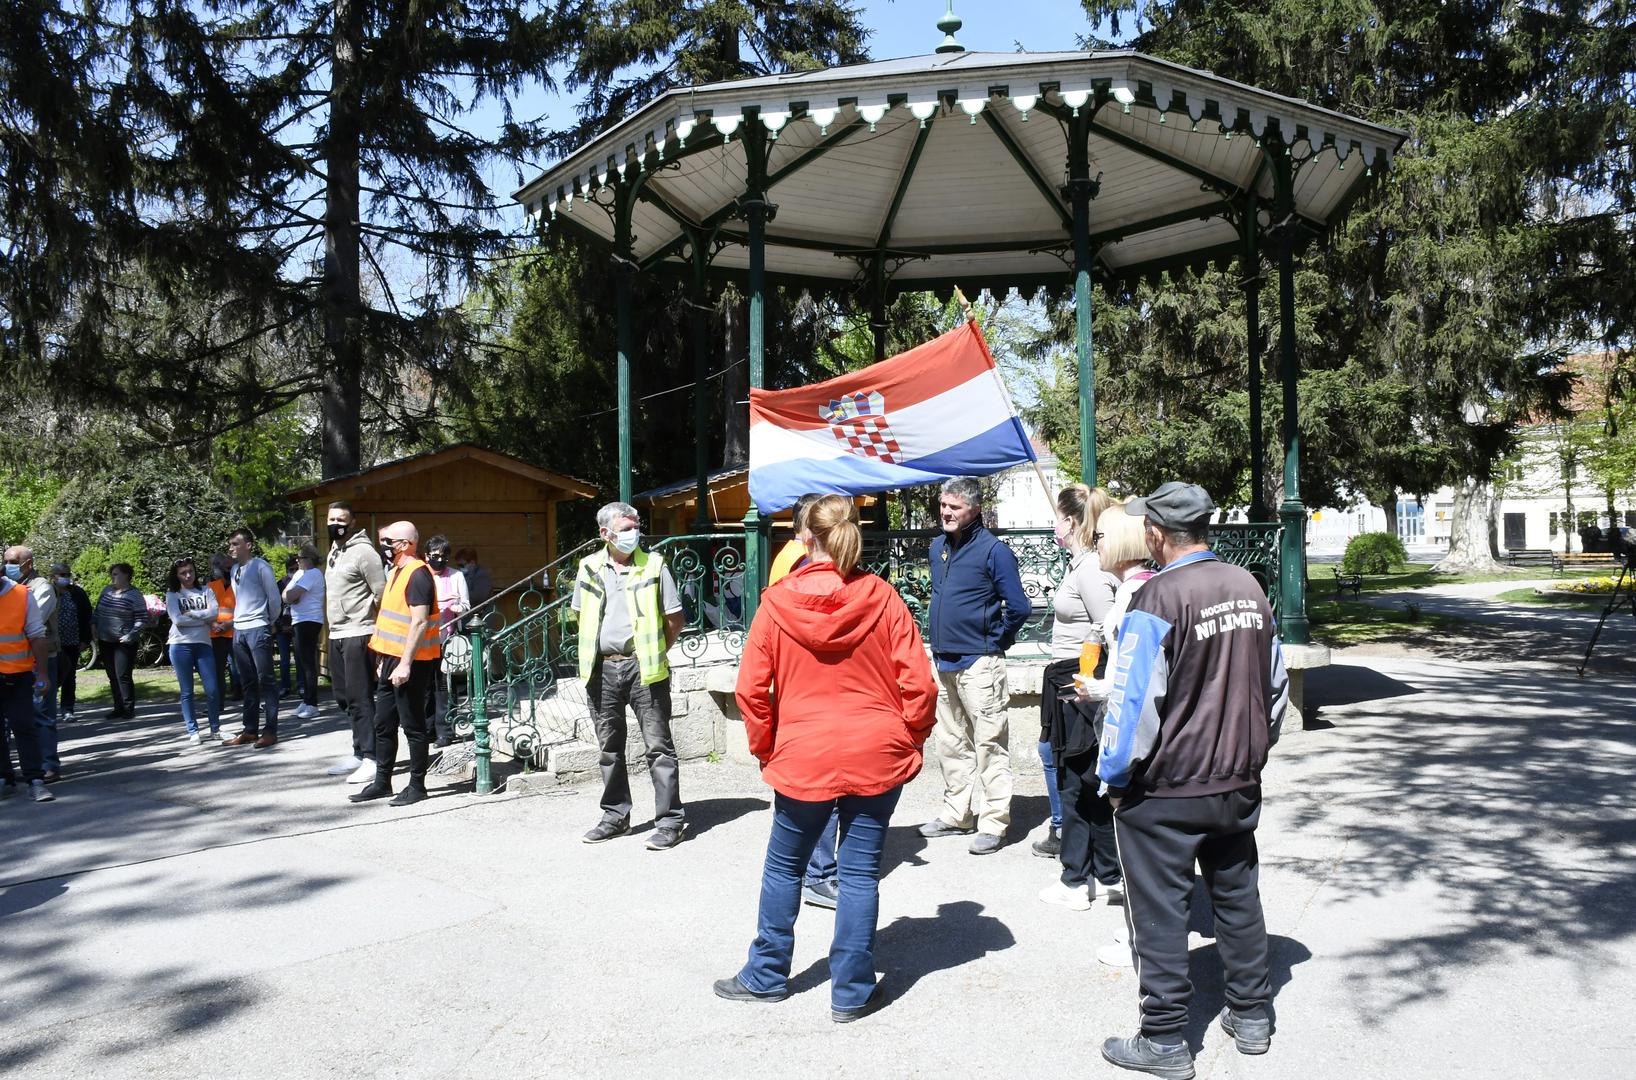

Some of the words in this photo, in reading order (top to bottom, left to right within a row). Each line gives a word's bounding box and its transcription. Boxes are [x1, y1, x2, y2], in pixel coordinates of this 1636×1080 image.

[1200, 600, 1235, 619] HOCKEY
[1194, 619, 1217, 641] NO
[1219, 611, 1264, 633] LIMITS
[1102, 632, 1139, 752] NIKE
